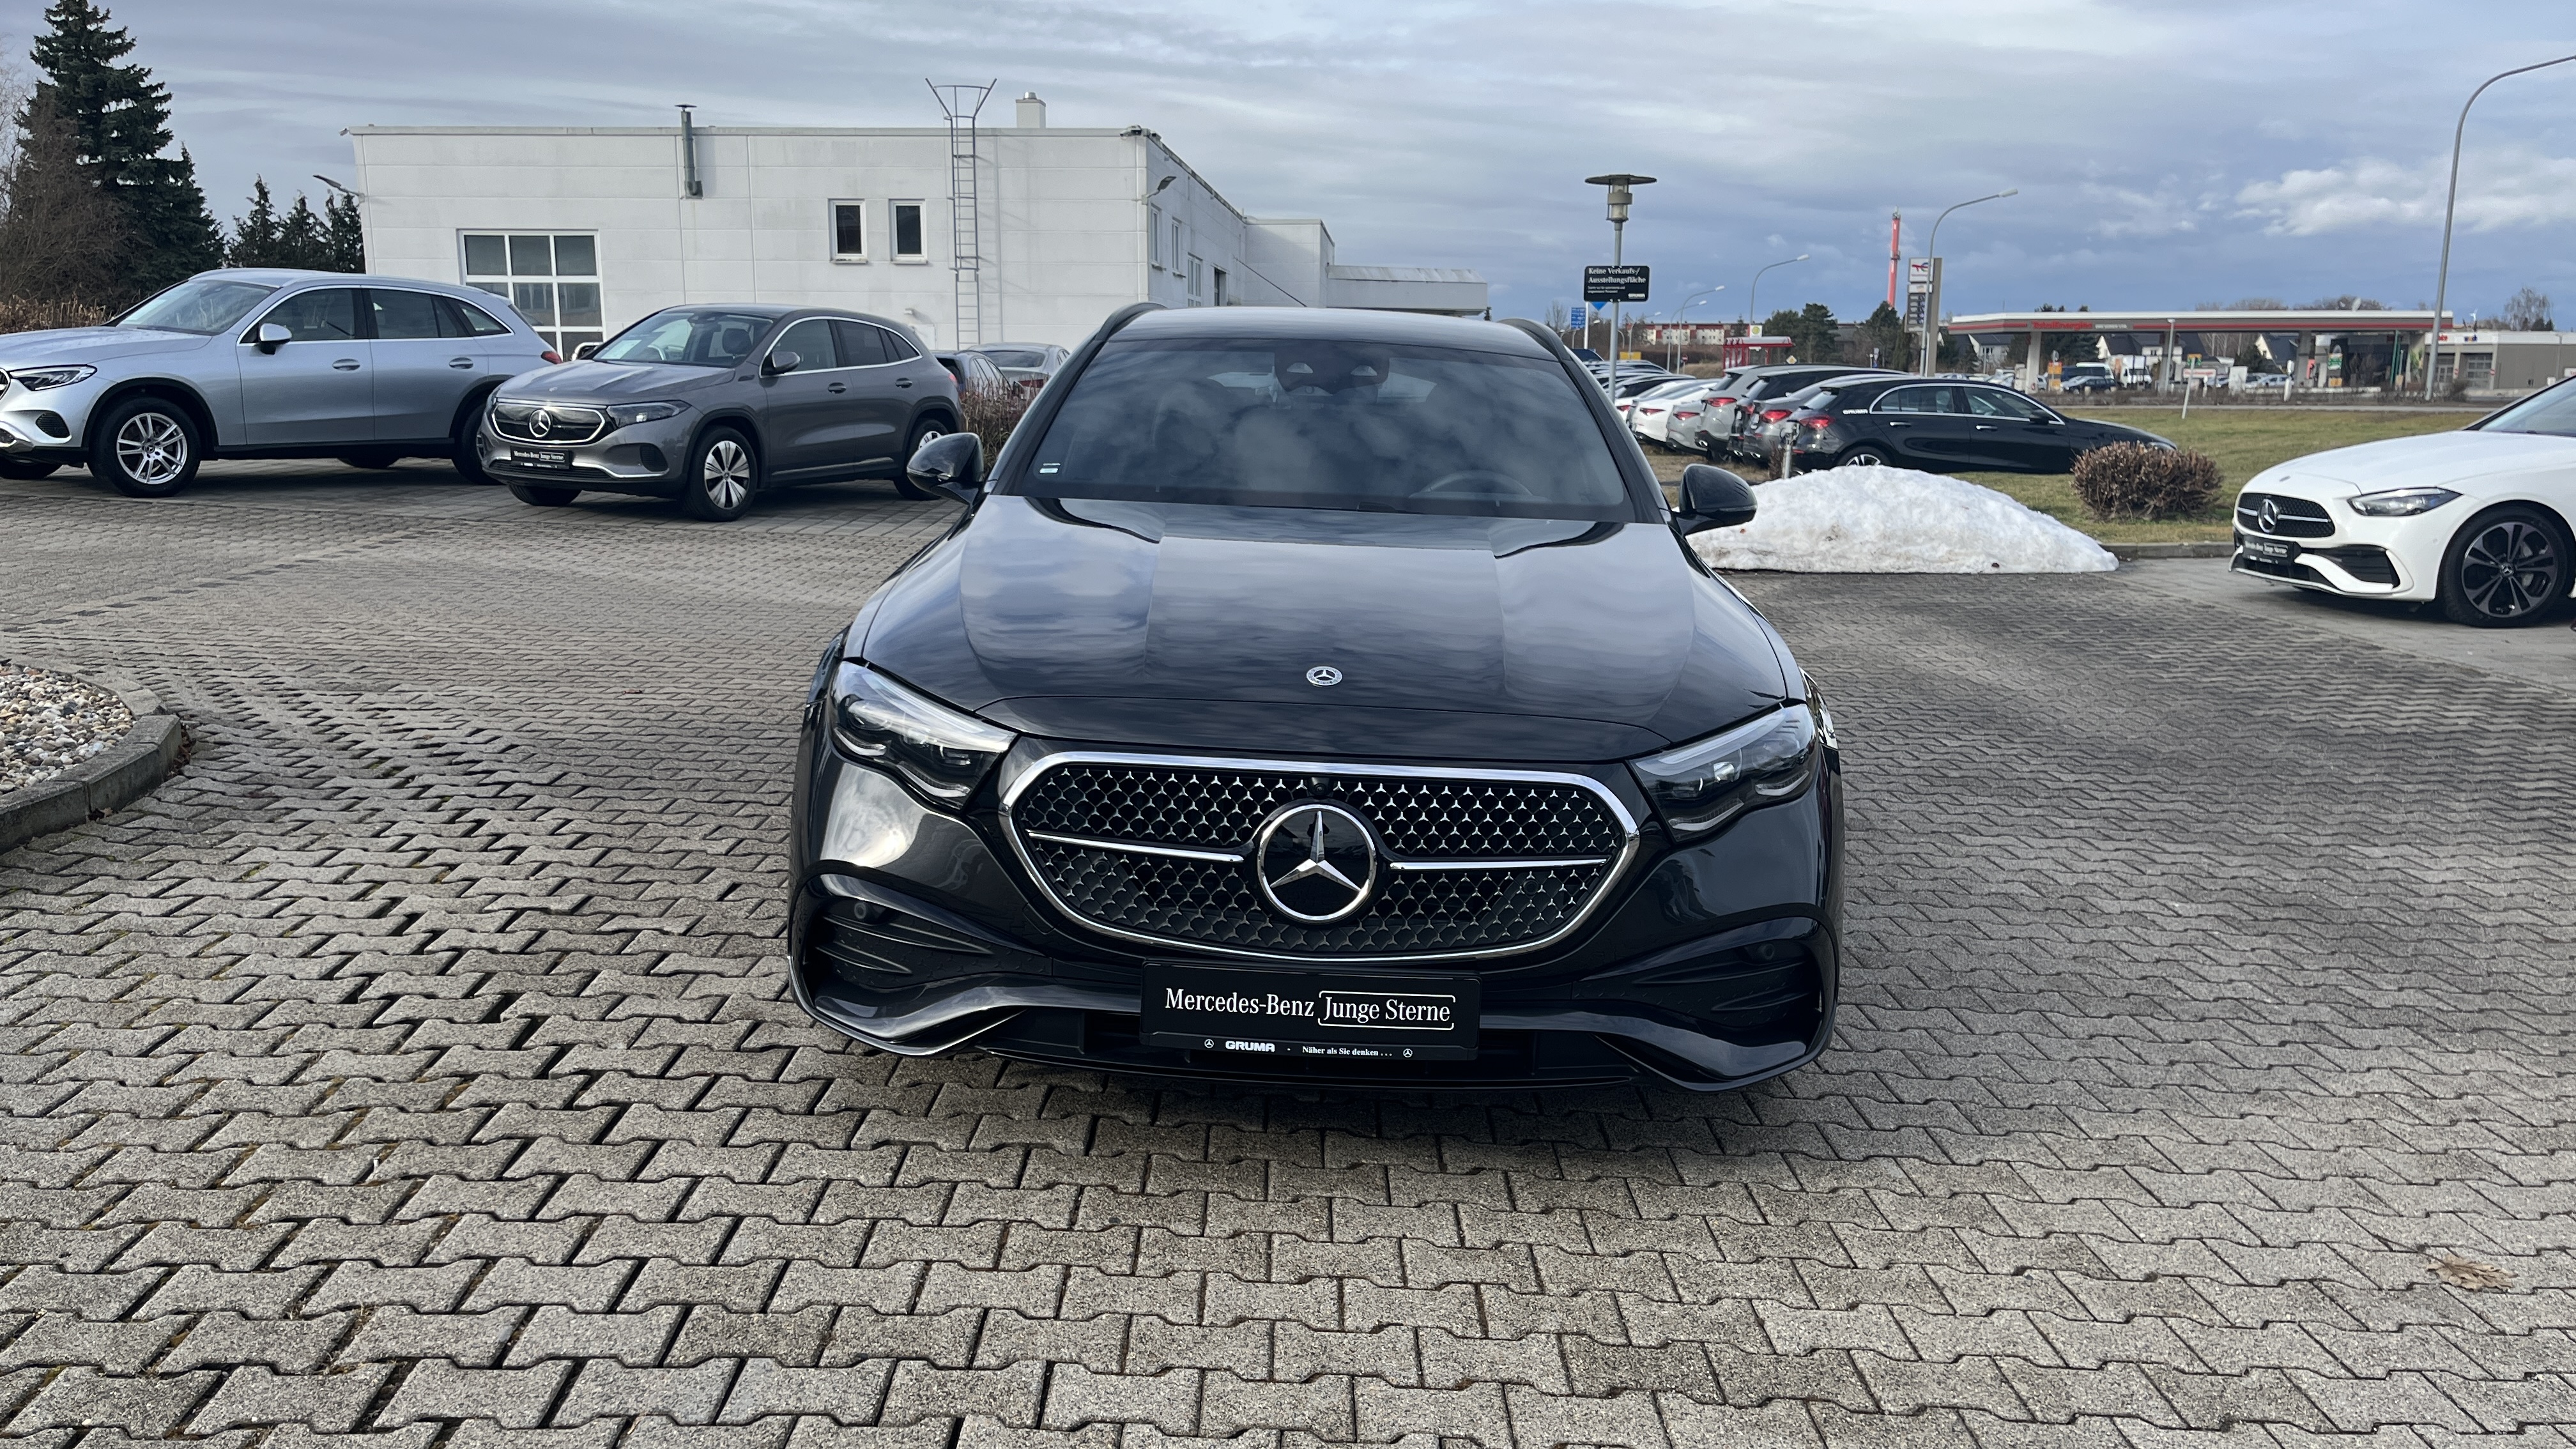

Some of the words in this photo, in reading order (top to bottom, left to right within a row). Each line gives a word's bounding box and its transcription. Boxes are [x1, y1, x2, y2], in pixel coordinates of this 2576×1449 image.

[1165, 988, 1315, 1017] Mercedes-Benz
[1323, 997, 1380, 1023] Junge
[1385, 999, 1450, 1022] Sterne
[1225, 1041, 1275, 1052] GRUMA
[1302, 1046, 1326, 1054] Näher
